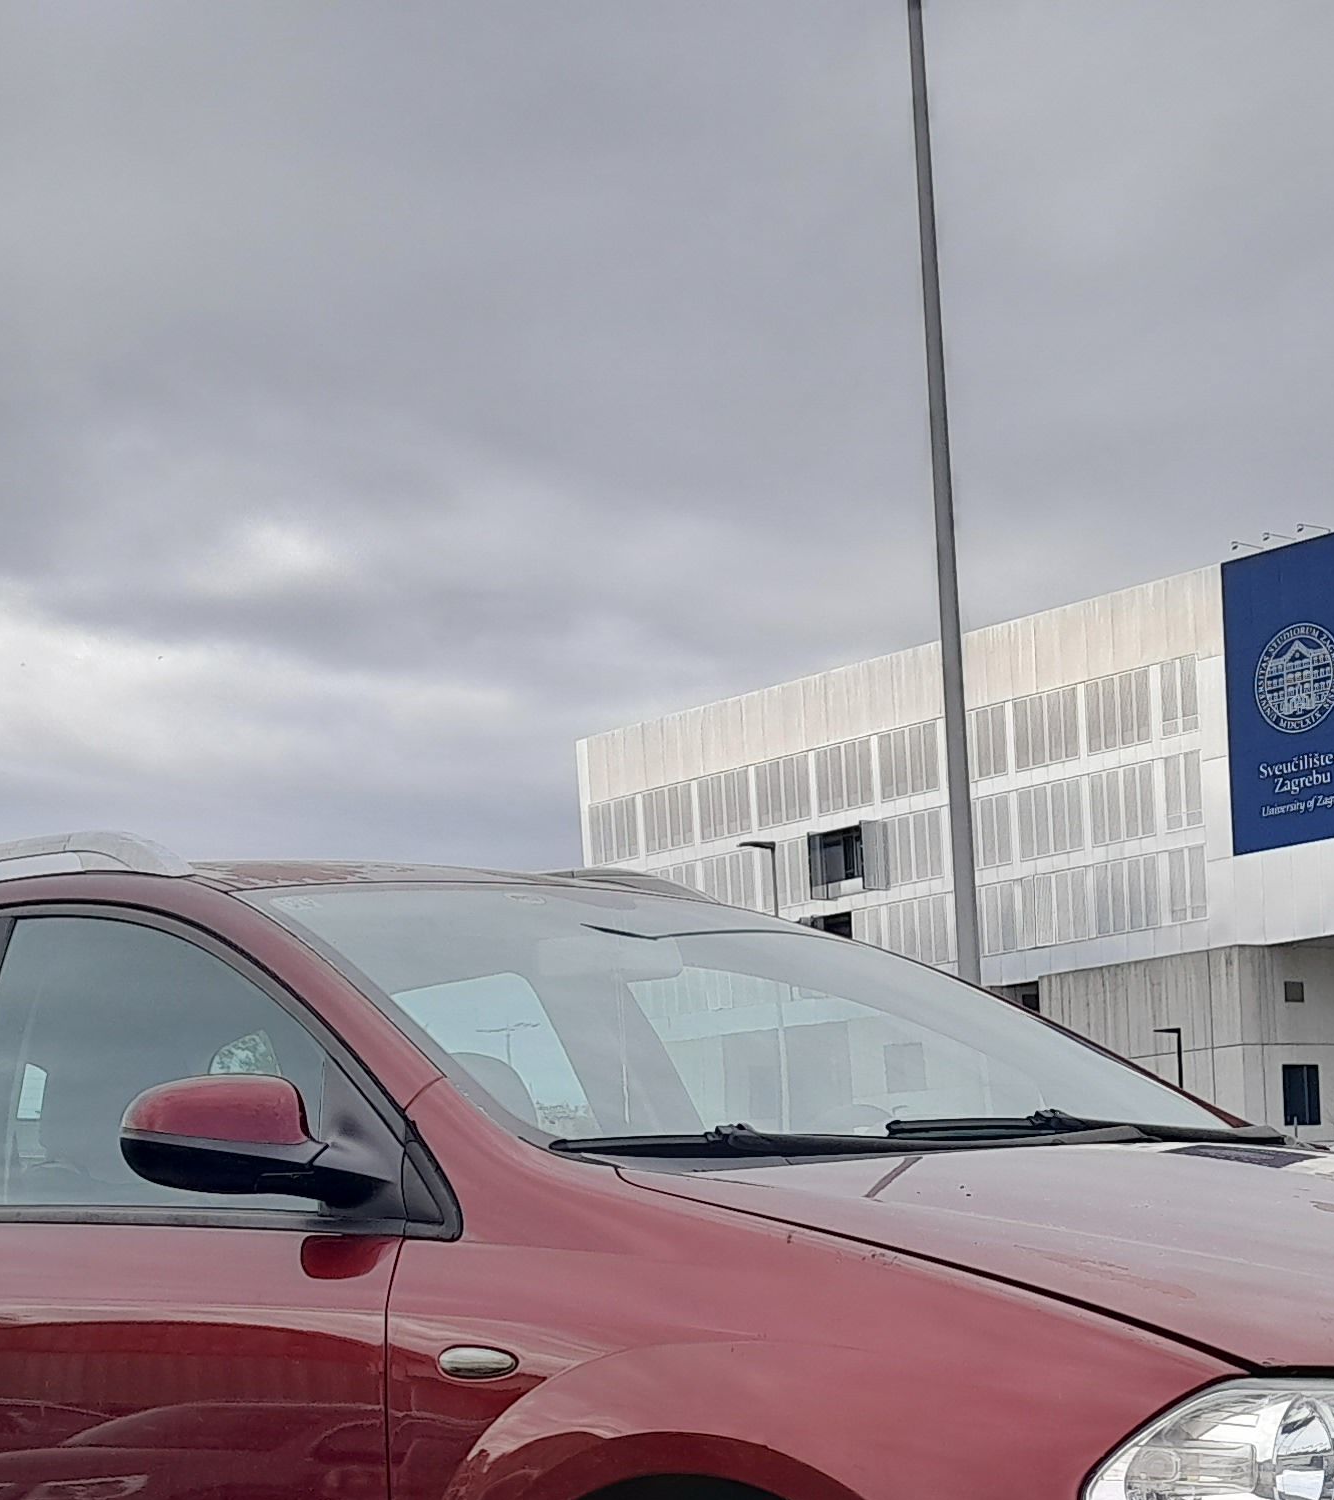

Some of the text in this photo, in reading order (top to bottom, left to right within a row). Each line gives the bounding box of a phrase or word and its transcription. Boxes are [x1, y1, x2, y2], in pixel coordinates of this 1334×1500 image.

[1259, 753, 1334, 779] Sveučilište
[1274, 769, 1331, 795] Zagrebu
[1262, 799, 1305, 817] University
[1306, 795, 1317, 812] of
